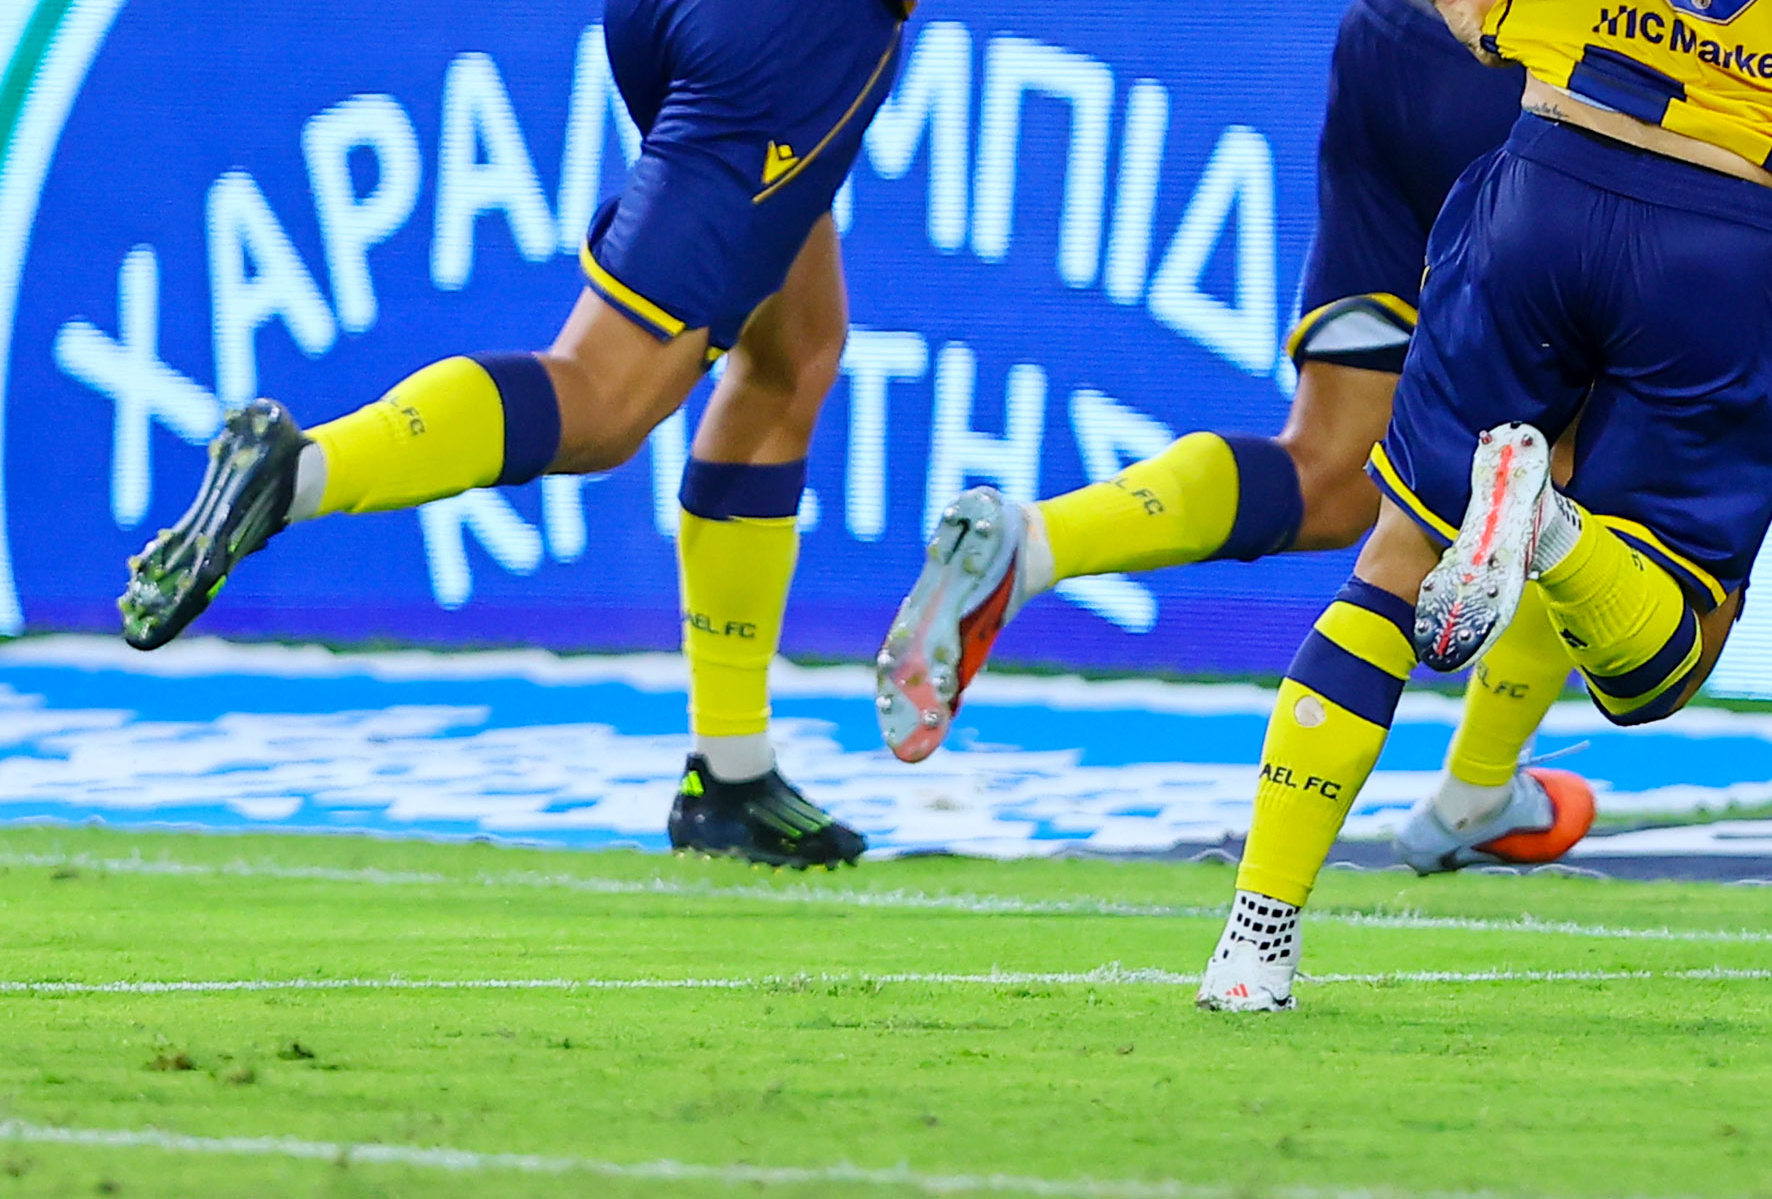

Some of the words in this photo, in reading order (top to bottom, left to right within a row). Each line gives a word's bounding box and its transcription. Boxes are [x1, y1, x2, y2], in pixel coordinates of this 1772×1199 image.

[725, 621, 756, 639] FC
[1259, 763, 1297, 788] AEL
[1303, 776, 1342, 800] FC
